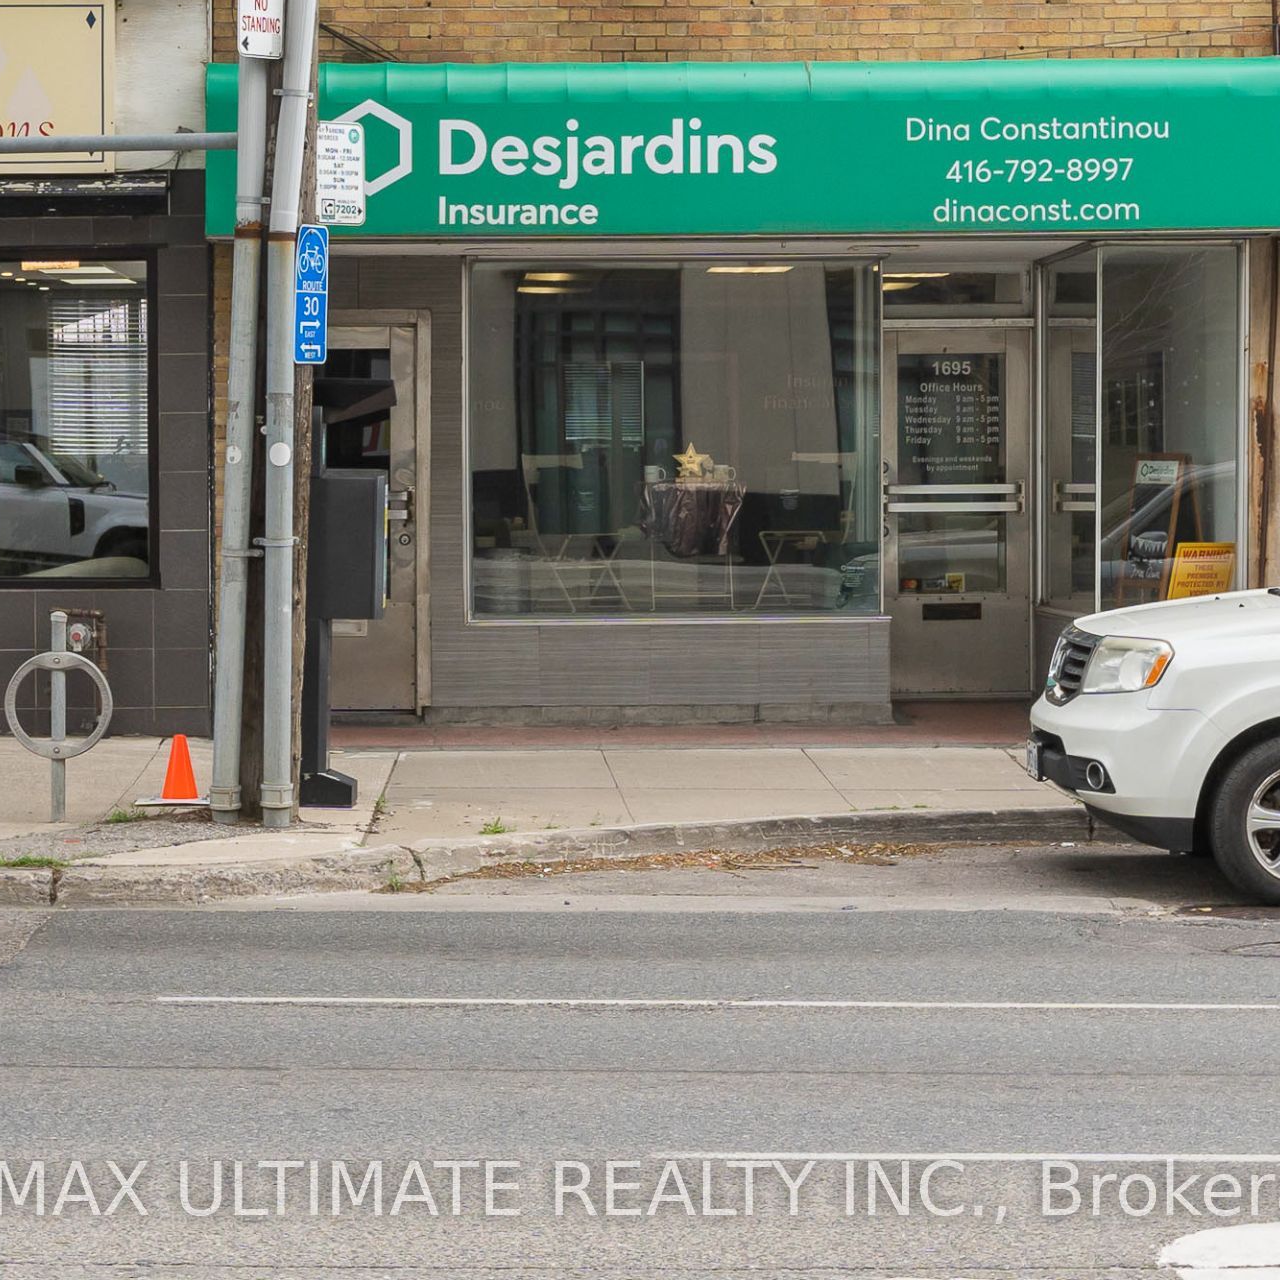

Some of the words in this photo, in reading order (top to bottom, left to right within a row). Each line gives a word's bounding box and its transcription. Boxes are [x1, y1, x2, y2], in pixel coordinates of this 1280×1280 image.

[241, 15, 281, 34] STANDING
[905, 117, 970, 141] Dina
[980, 116, 1170, 141] Constantinou
[439, 117, 778, 189] Desjardins
[945, 158, 1134, 183] 416-792-8997
[335, 204, 357, 215] 7202
[438, 196, 599, 225] Insurance
[933, 198, 1140, 222] dinaconst.com
[302, 281, 323, 291] ROUTE
[303, 296, 319, 316] 30
[931, 361, 972, 376] 1695
[920, 383, 950, 393] Office
[953, 383, 983, 393] Hours
[905, 395, 937, 405] Monday
[986, 396, 999, 404] pm
[905, 406, 938, 416] Tuesday
[986, 407, 999, 415] pm
[905, 416, 951, 425] Wednesday
[986, 416, 999, 424] pm
[905, 426, 942, 435] Thursday
[986, 427, 999, 435] pm
[905, 436, 932, 445] Friday
[986, 437, 999, 445] pm
[912, 455, 943, 464] Evenings
[926, 464, 935, 472] by
[936, 464, 979, 472] appointment
